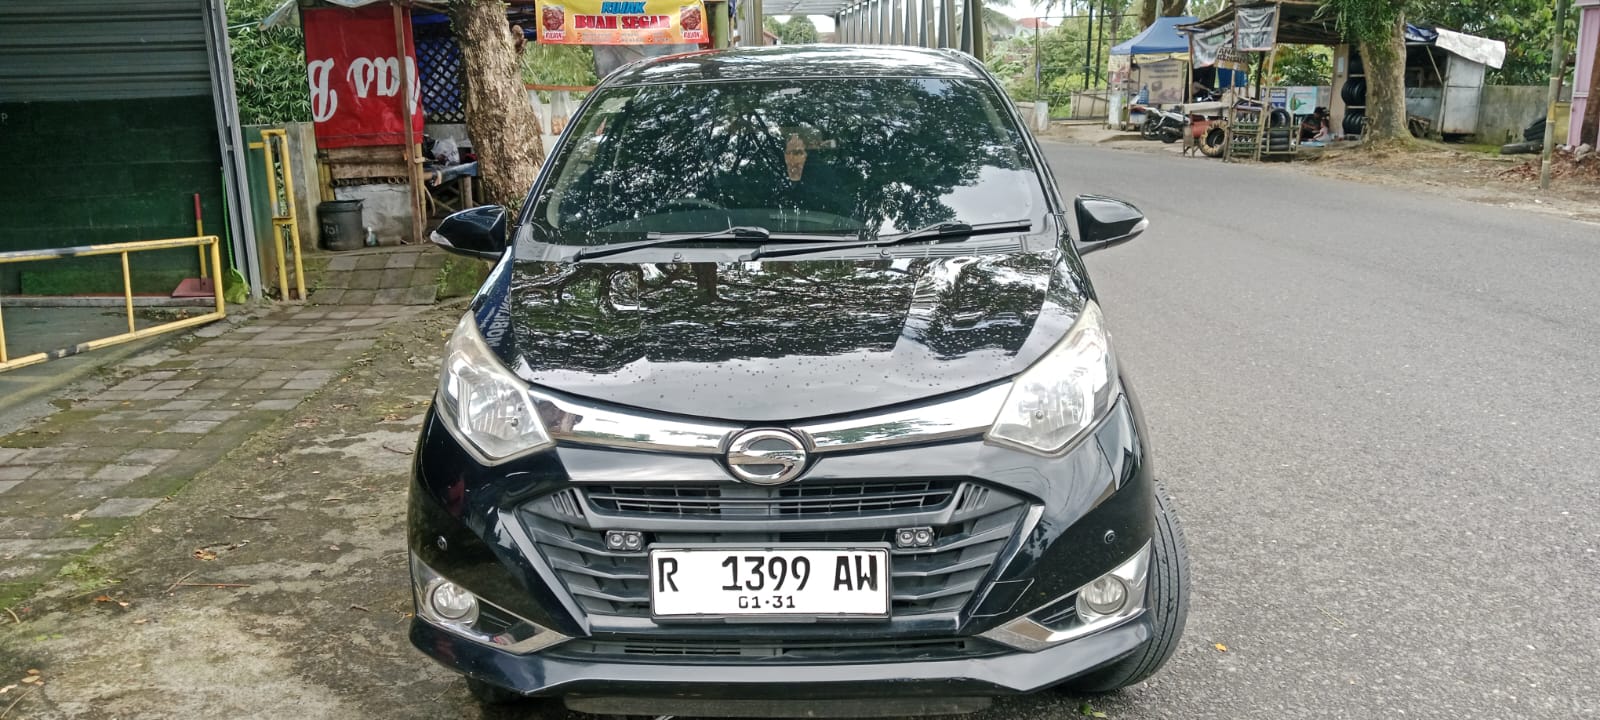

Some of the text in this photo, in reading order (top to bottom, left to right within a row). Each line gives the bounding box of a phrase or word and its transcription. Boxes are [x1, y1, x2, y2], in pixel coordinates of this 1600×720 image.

[601, 1, 646, 14] RUJAK
[575, 15, 671, 29] BUAH SEGAR
[657, 554, 878, 592] R 1399 AW
